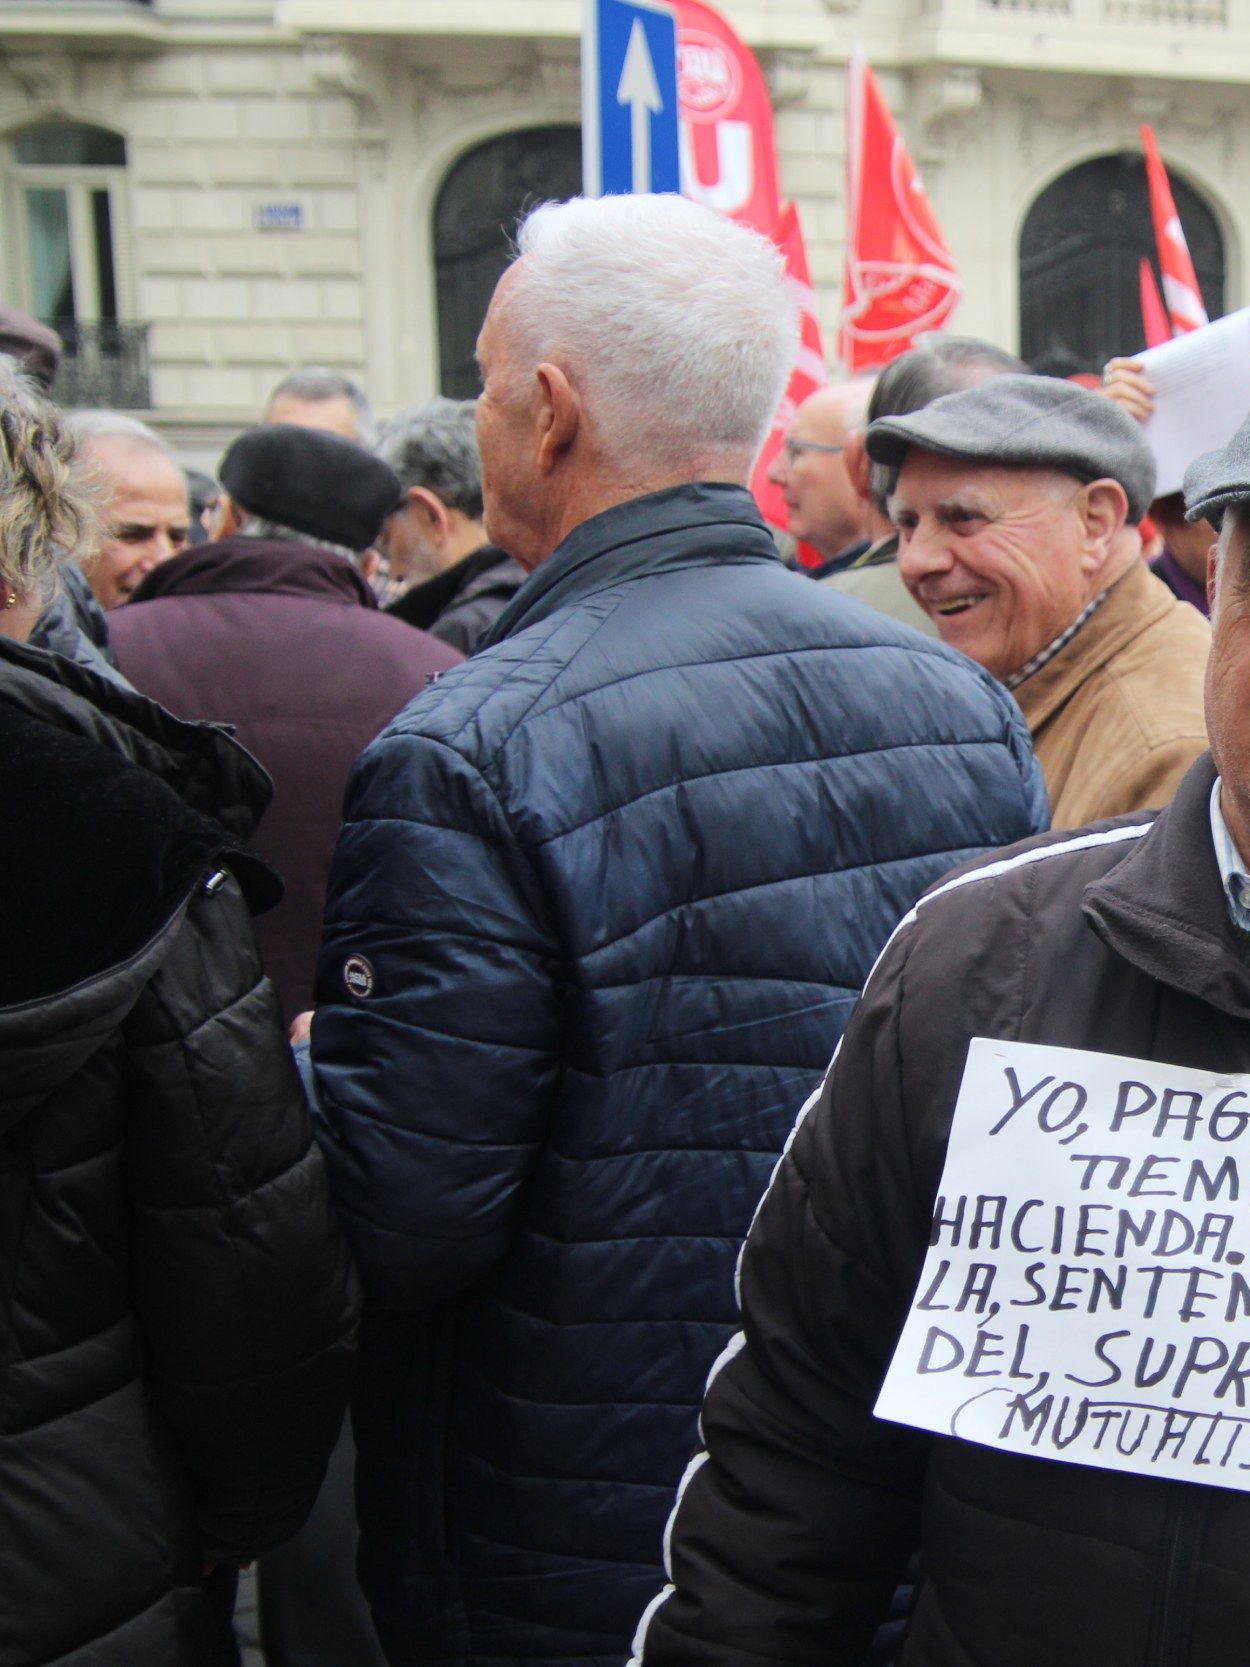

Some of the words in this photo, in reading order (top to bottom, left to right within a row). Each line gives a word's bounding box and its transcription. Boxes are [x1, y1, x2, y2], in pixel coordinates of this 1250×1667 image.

[989, 1066, 1089, 1145] YO,
[928, 1195, 1246, 1266] HACIENDA.
[916, 1259, 1001, 1329] LA,
[916, 1323, 1050, 1401] DEL,
